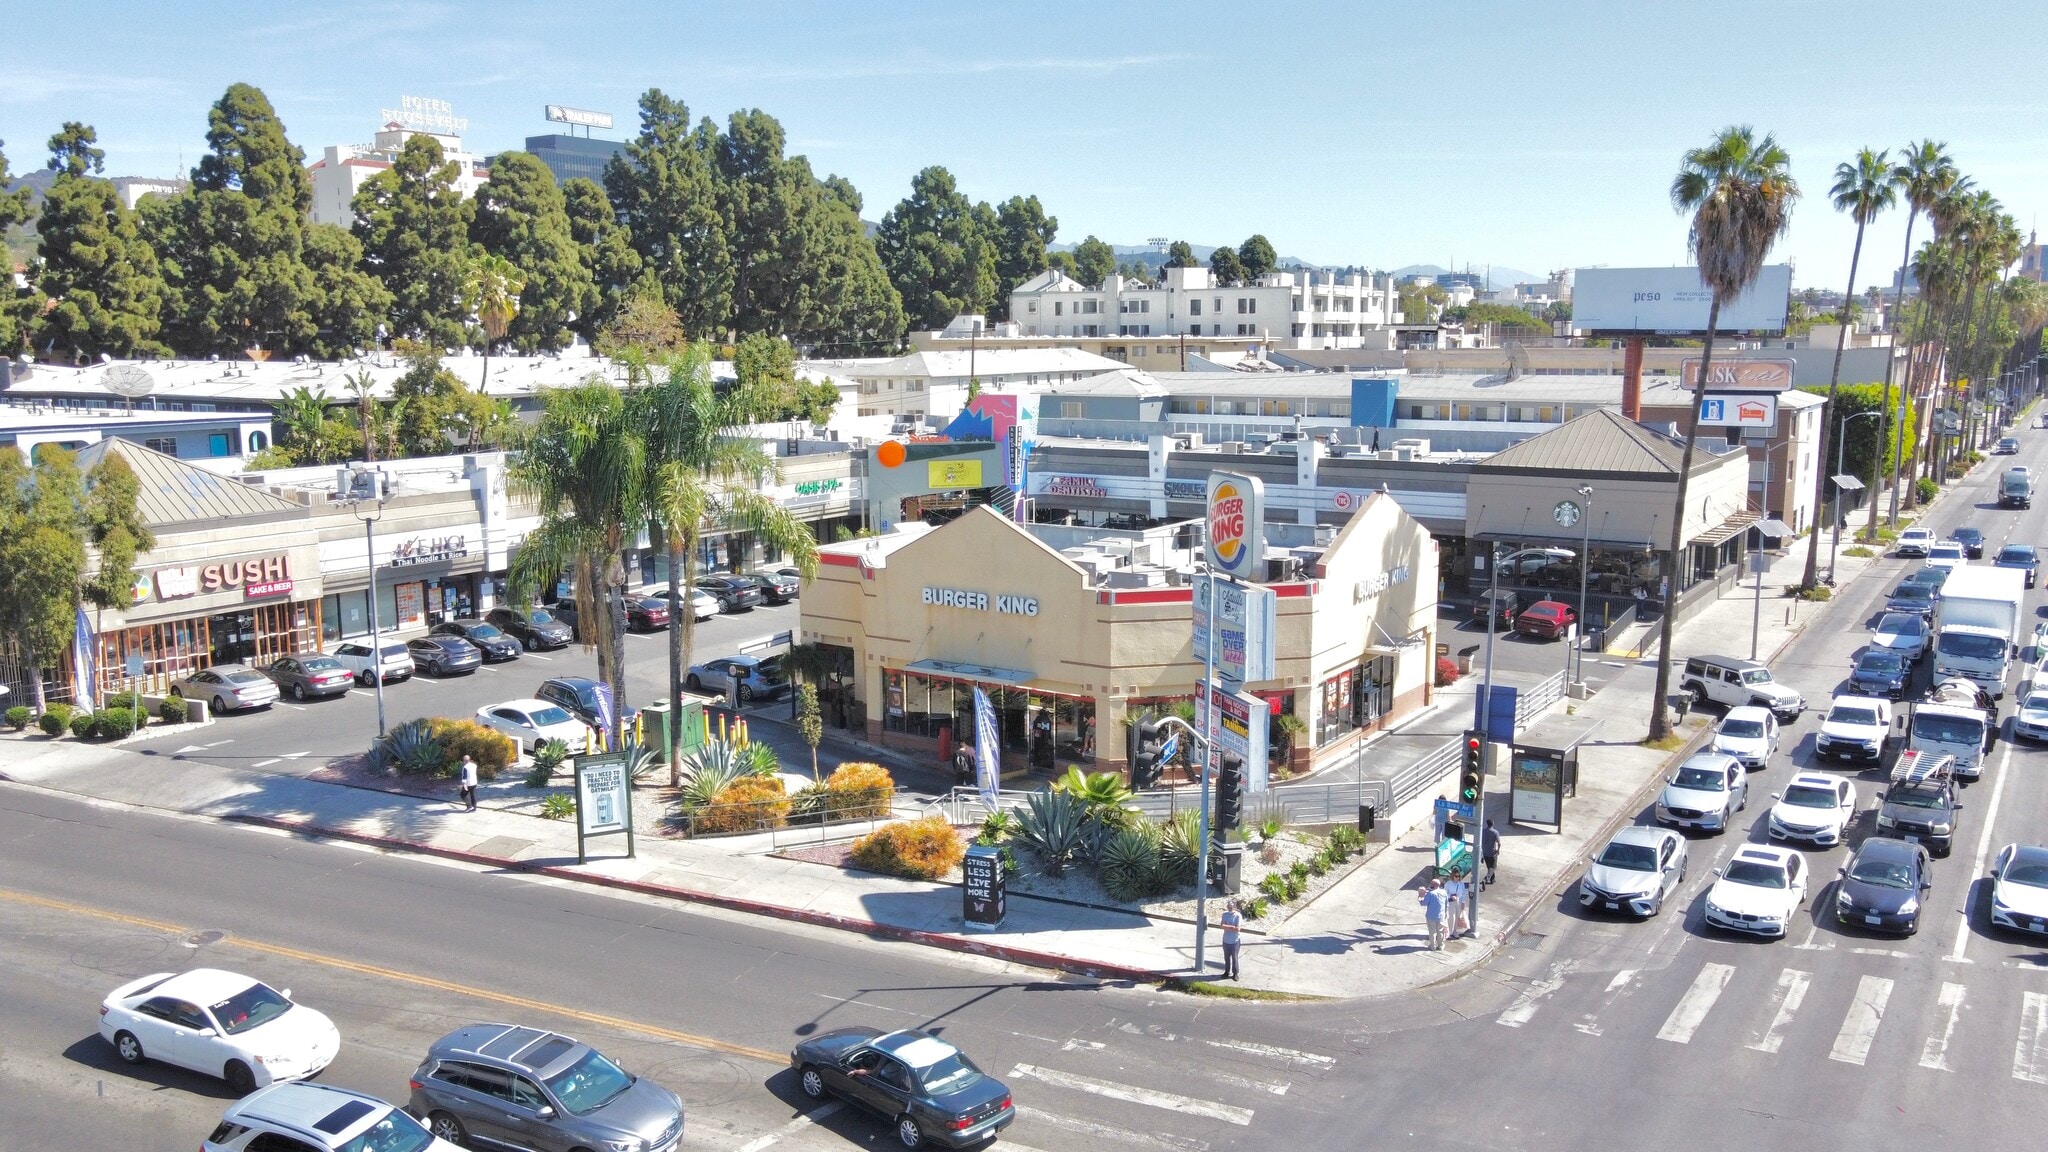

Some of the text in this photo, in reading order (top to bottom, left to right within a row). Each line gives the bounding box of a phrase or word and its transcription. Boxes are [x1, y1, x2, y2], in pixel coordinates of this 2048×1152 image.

[402, 95, 452, 113] HOTEL
[381, 108, 468, 130] ROOSEVELT
[1634, 292, 1661, 303] peso
[821, 479, 838, 491] SPA
[1059, 477, 1097, 487] FAMILY
[1051, 486, 1108, 497] DENTISTRY
[1211, 498, 1243, 522] BURGER
[1212, 514, 1244, 545] KING
[397, 558, 413, 566] Thai
[415, 554, 439, 563] Noodle
[203, 556, 291, 588] SUSHI
[1358, 566, 1409, 598] BURGER KING
[249, 582, 292, 595] SAKE & BEER
[922, 587, 1038, 617] BURGER KING
[1222, 589, 1243, 606] Adults
[1223, 639, 1243, 651] OVER
[1225, 650, 1244, 664] PIZZA
[1223, 717, 1249, 738] TANNING
[587, 775, 612, 783] PRACTICE
[967, 859, 991, 867] STRESS
[968, 867, 991, 877] LESS
[968, 878, 991, 888] LIVE
[967, 888, 990, 898] MORE
